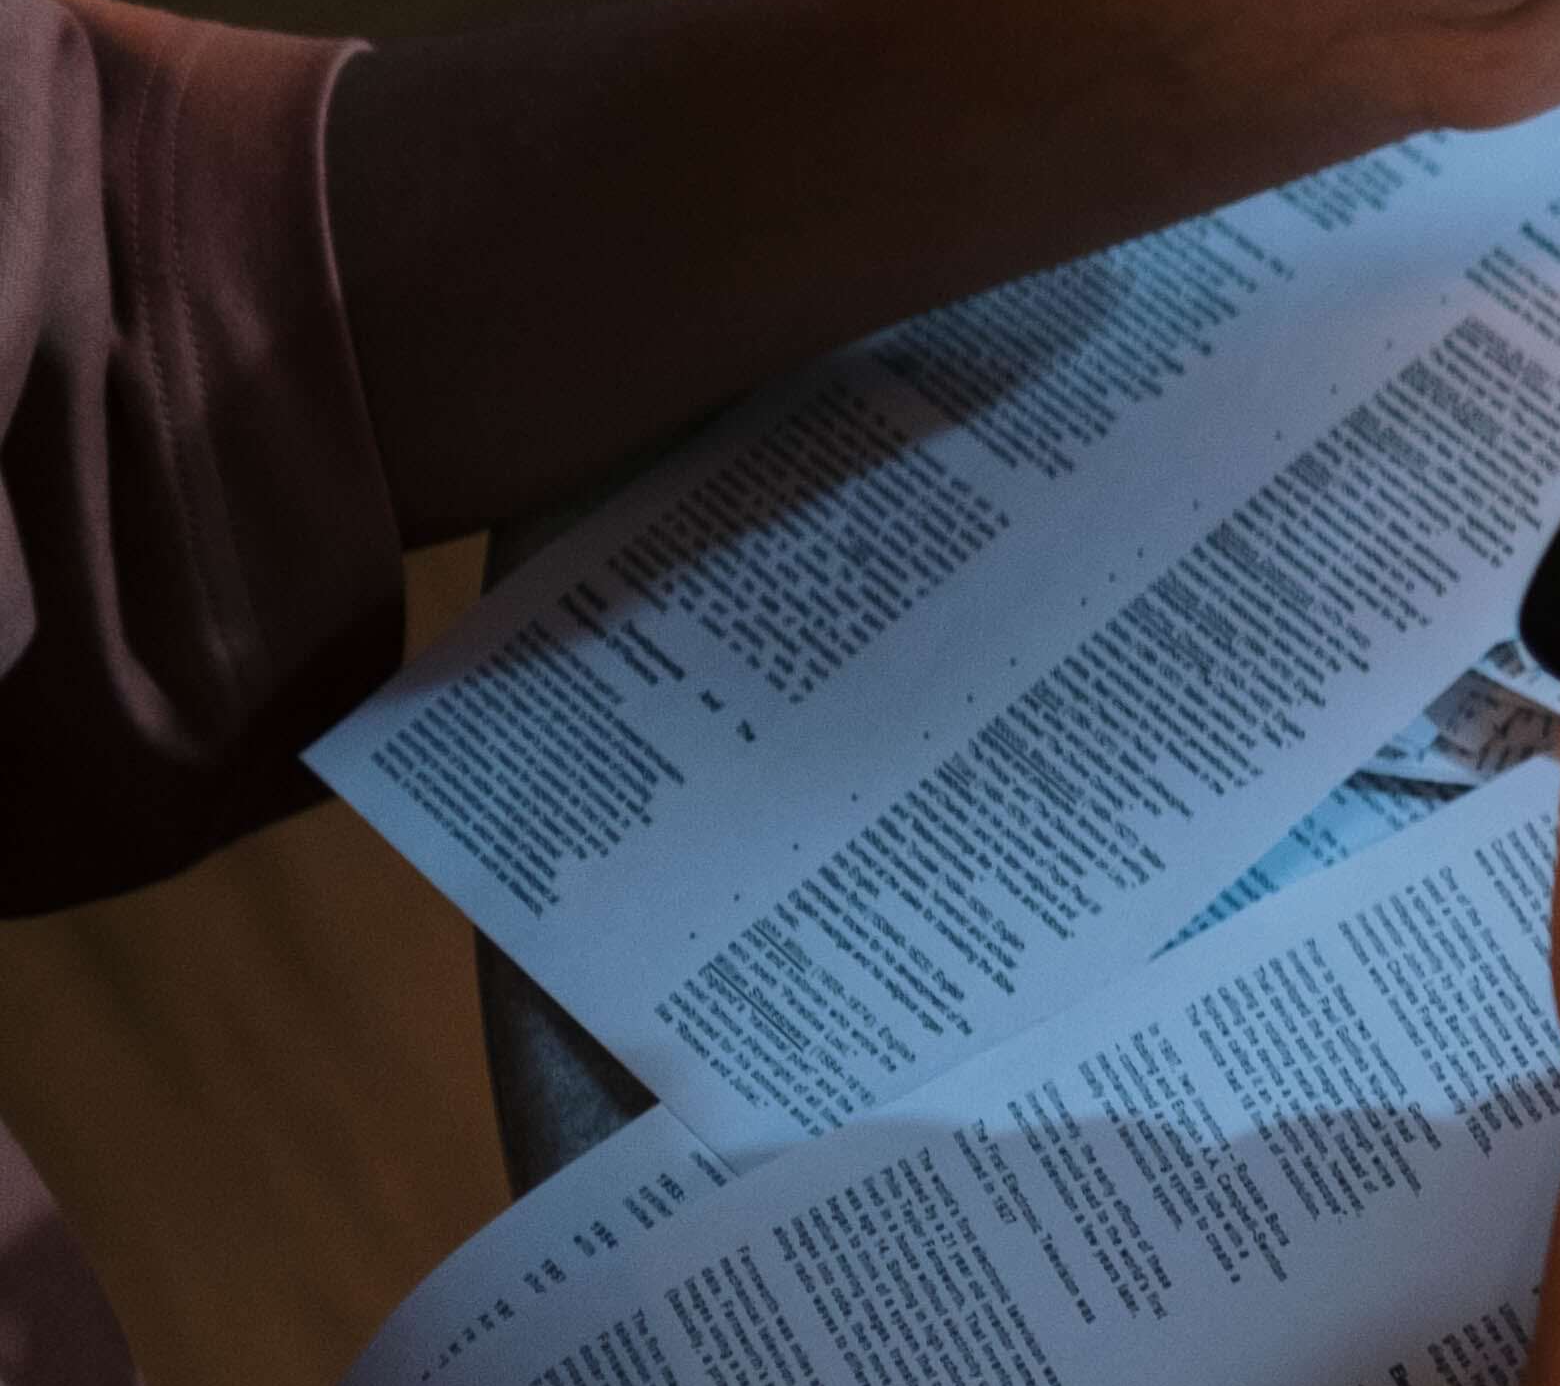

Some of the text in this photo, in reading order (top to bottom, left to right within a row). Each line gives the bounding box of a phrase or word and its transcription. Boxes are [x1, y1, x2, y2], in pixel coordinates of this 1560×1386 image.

[952, 1128, 990, 1182] invented
[992, 1194, 1018, 1225] 1927
[974, 1118, 1097, 1325] The First Electronic Television was
